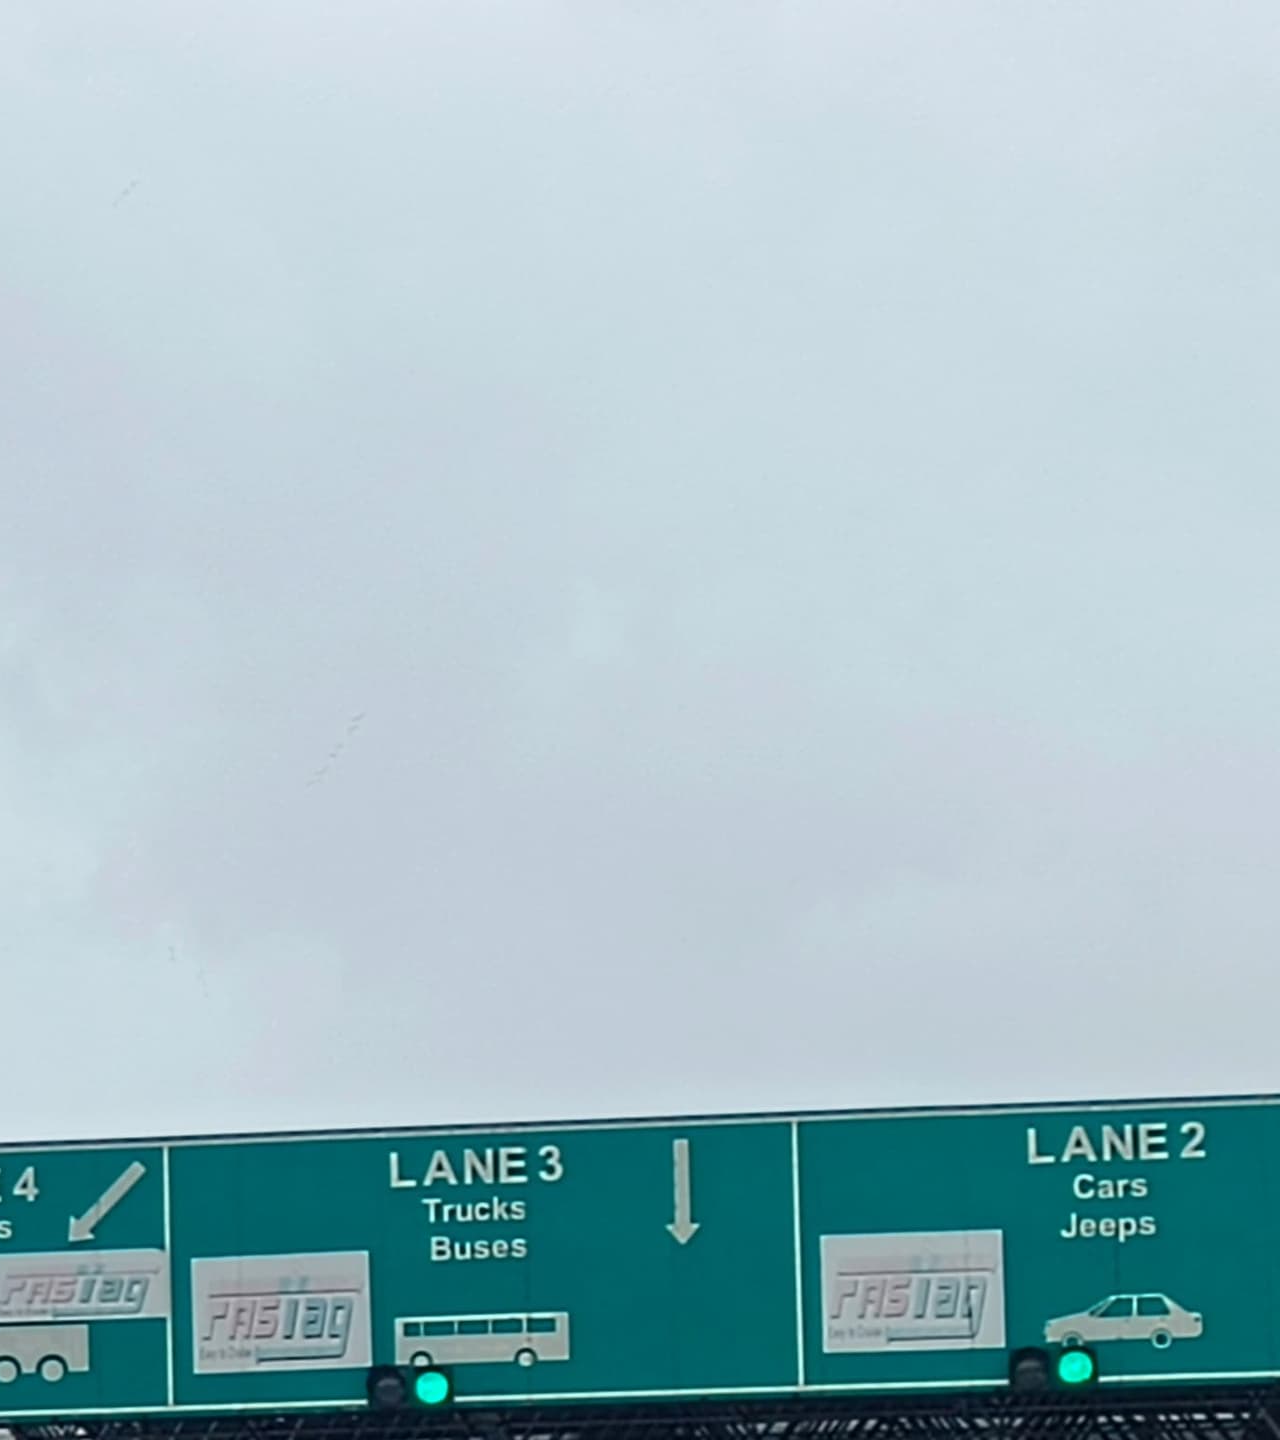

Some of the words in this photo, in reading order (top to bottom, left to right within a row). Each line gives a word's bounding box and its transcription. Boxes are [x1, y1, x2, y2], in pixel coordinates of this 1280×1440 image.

[1027, 1122, 1170, 1164] LANE
[1180, 1121, 1207, 1158] 2
[389, 1147, 529, 1188] LANE
[538, 1145, 565, 1182] 3
[13, 1166, 40, 1202] 4
[1073, 1173, 1148, 1199] Cars
[421, 1196, 527, 1223] Trucks
[1060, 1212, 1157, 1243] Jeeps
[430, 1236, 528, 1261] Buses
